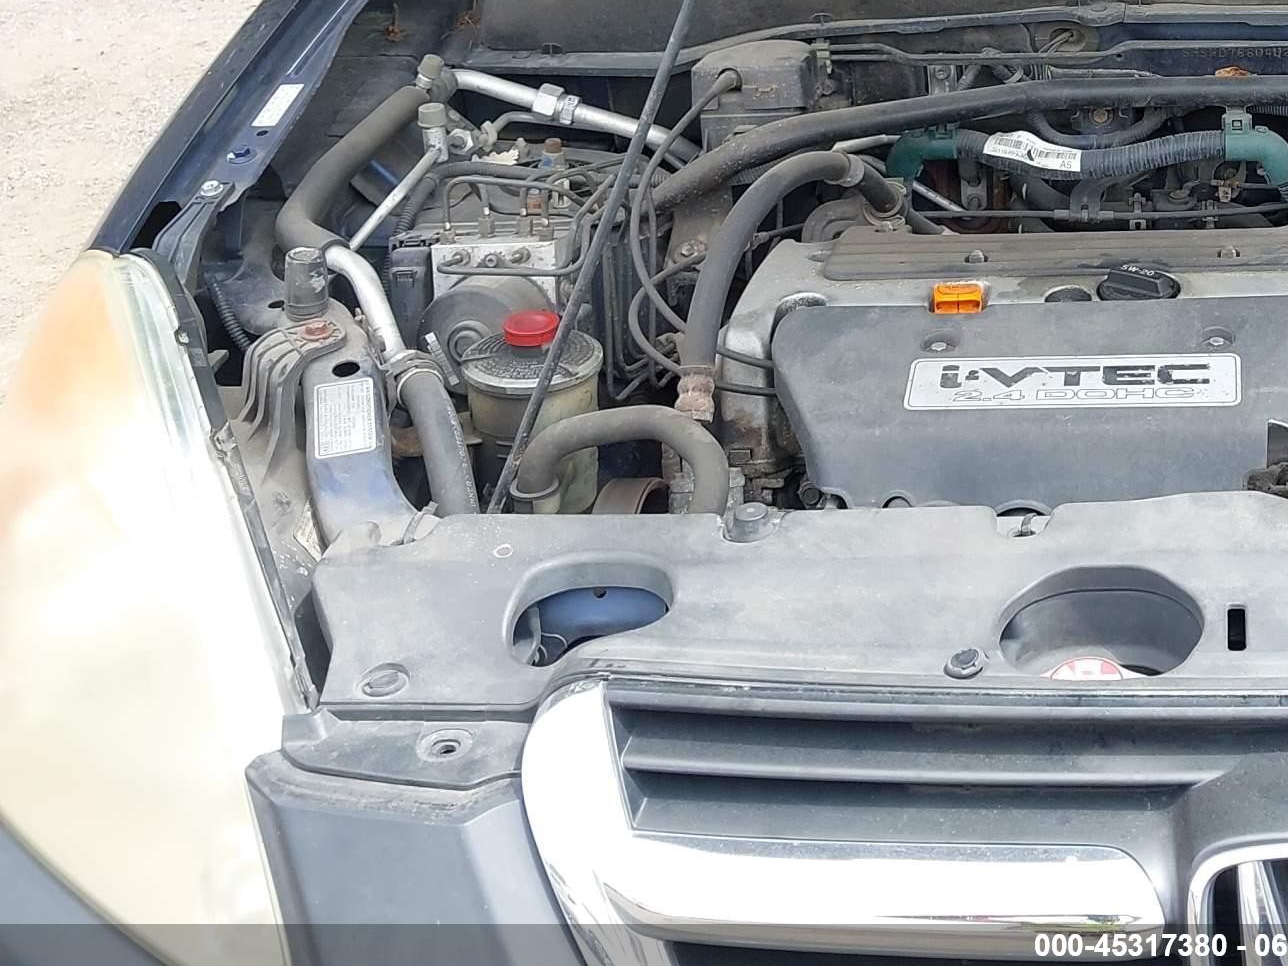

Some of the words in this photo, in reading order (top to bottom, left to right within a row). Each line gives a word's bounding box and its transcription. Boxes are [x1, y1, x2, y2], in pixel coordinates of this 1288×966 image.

[1120, 264, 1155, 276] 5W-20
[939, 364, 1211, 389] i-VTEC
[952, 389, 1025, 402] 2.4
[1036, 387, 1195, 399] DOHC
